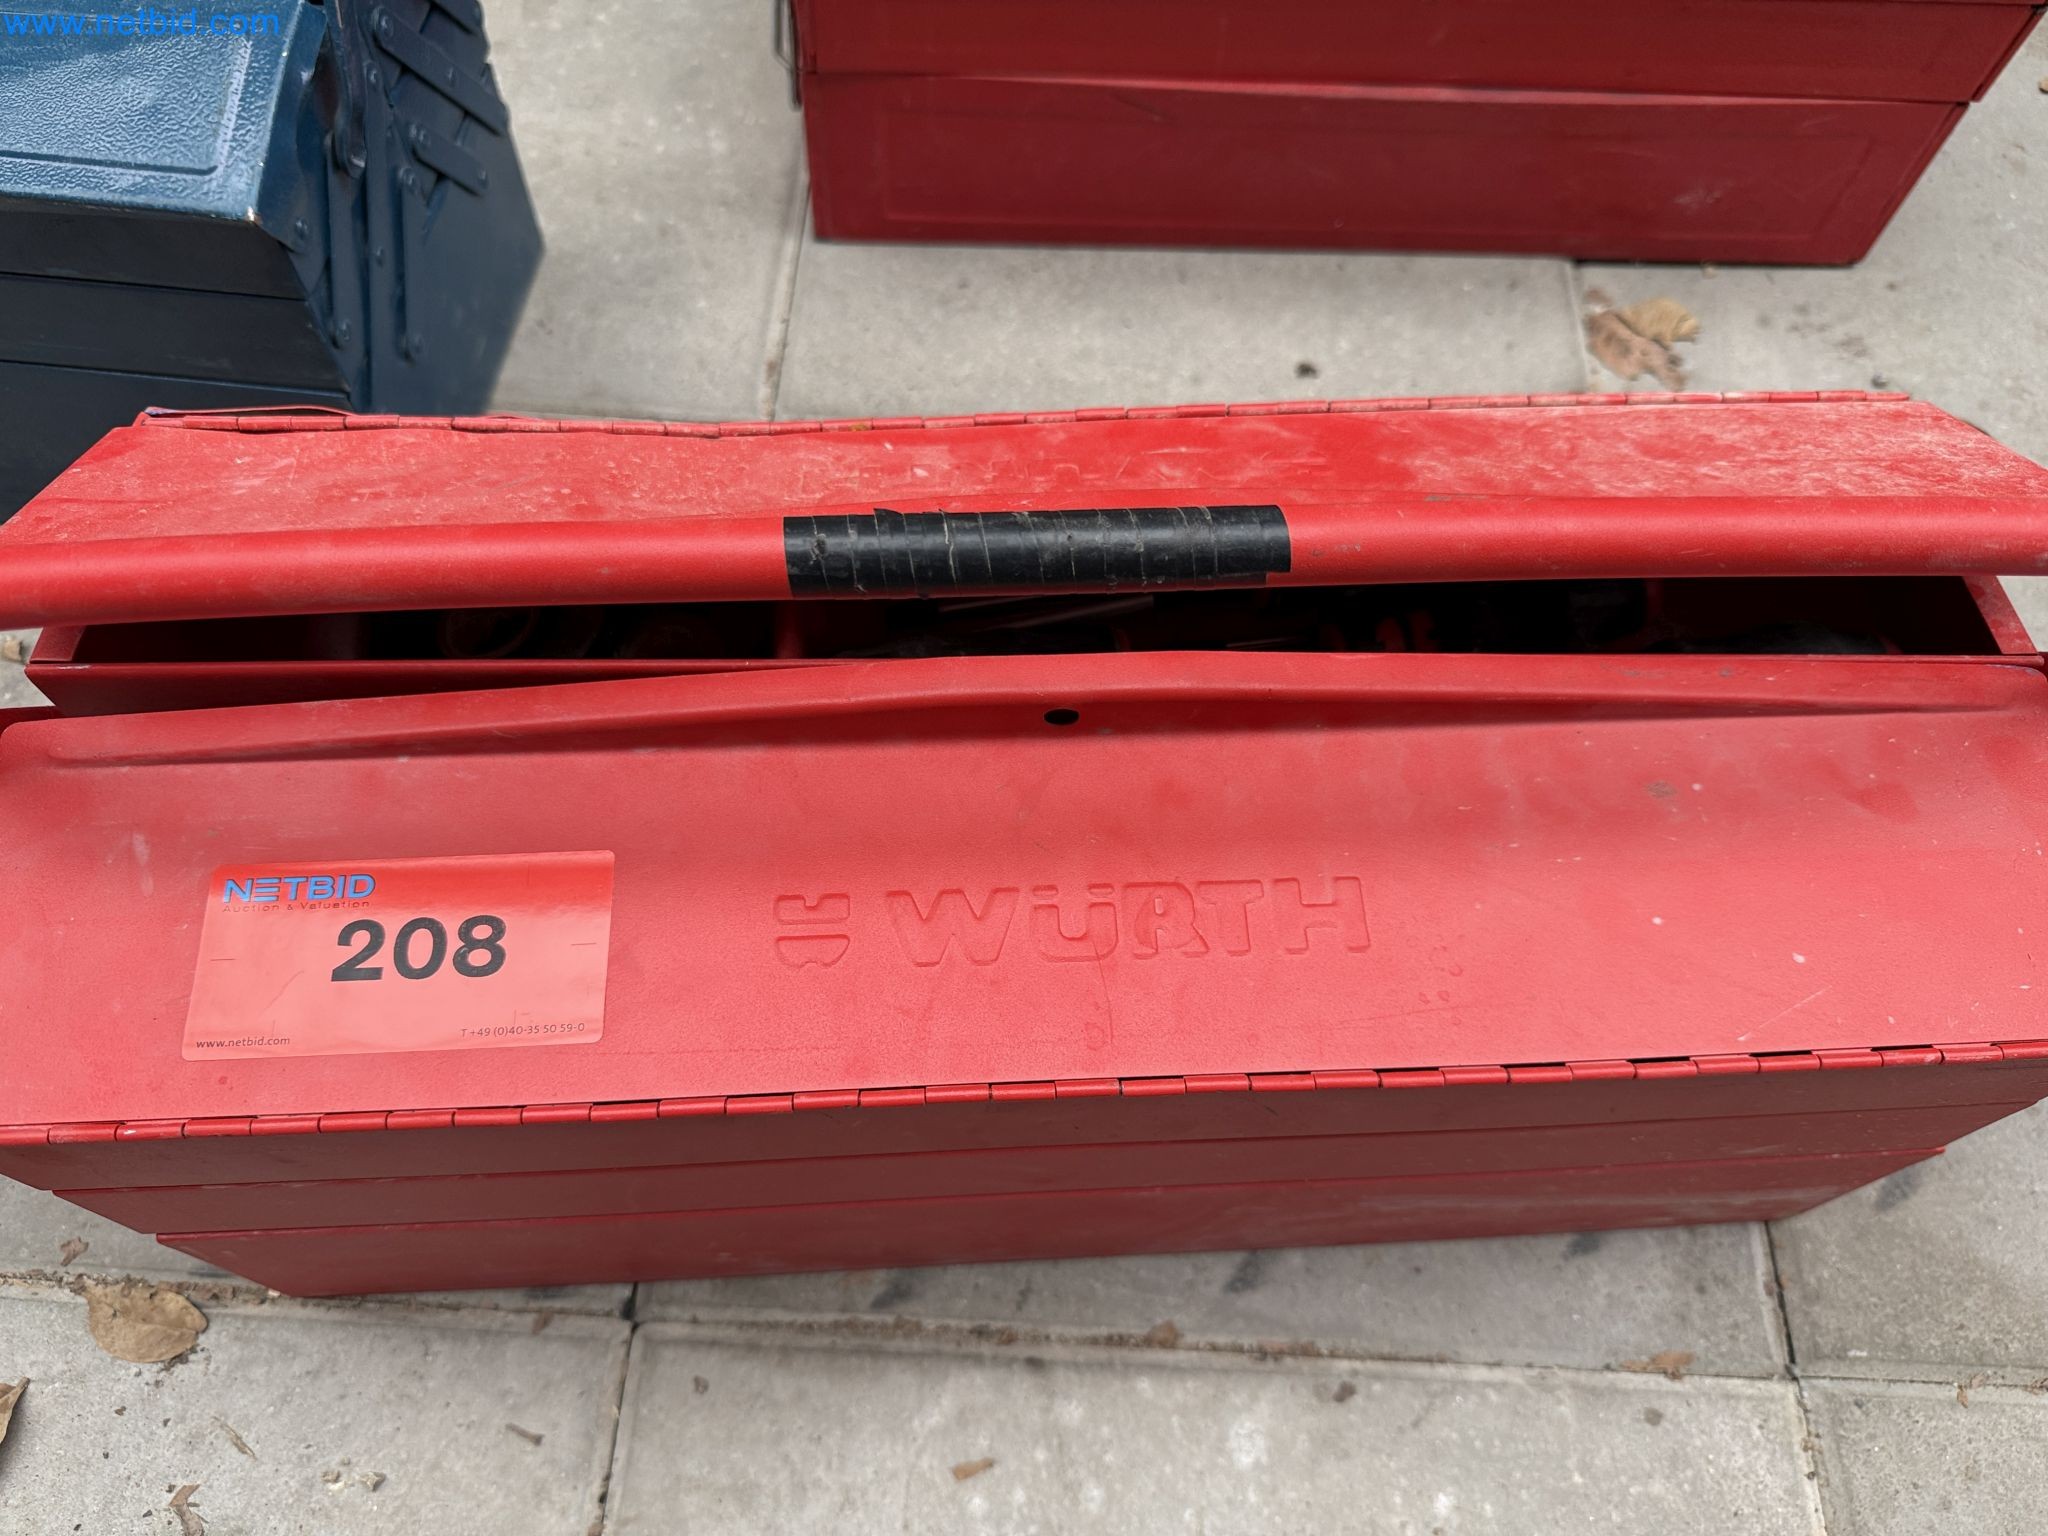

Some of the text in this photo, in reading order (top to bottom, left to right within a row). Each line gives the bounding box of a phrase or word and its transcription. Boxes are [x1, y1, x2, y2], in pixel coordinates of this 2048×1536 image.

[223, 874, 376, 903] NETBID
[222, 904, 280, 913] Auction
[286, 903, 294, 911] &
[887, 875, 1371, 967] WÜRTH
[331, 914, 507, 982] 208
[461, 1022, 585, 1037] T +49 (0)40-35 50 59-0
[196, 1036, 291, 1048] www.netbid.com
